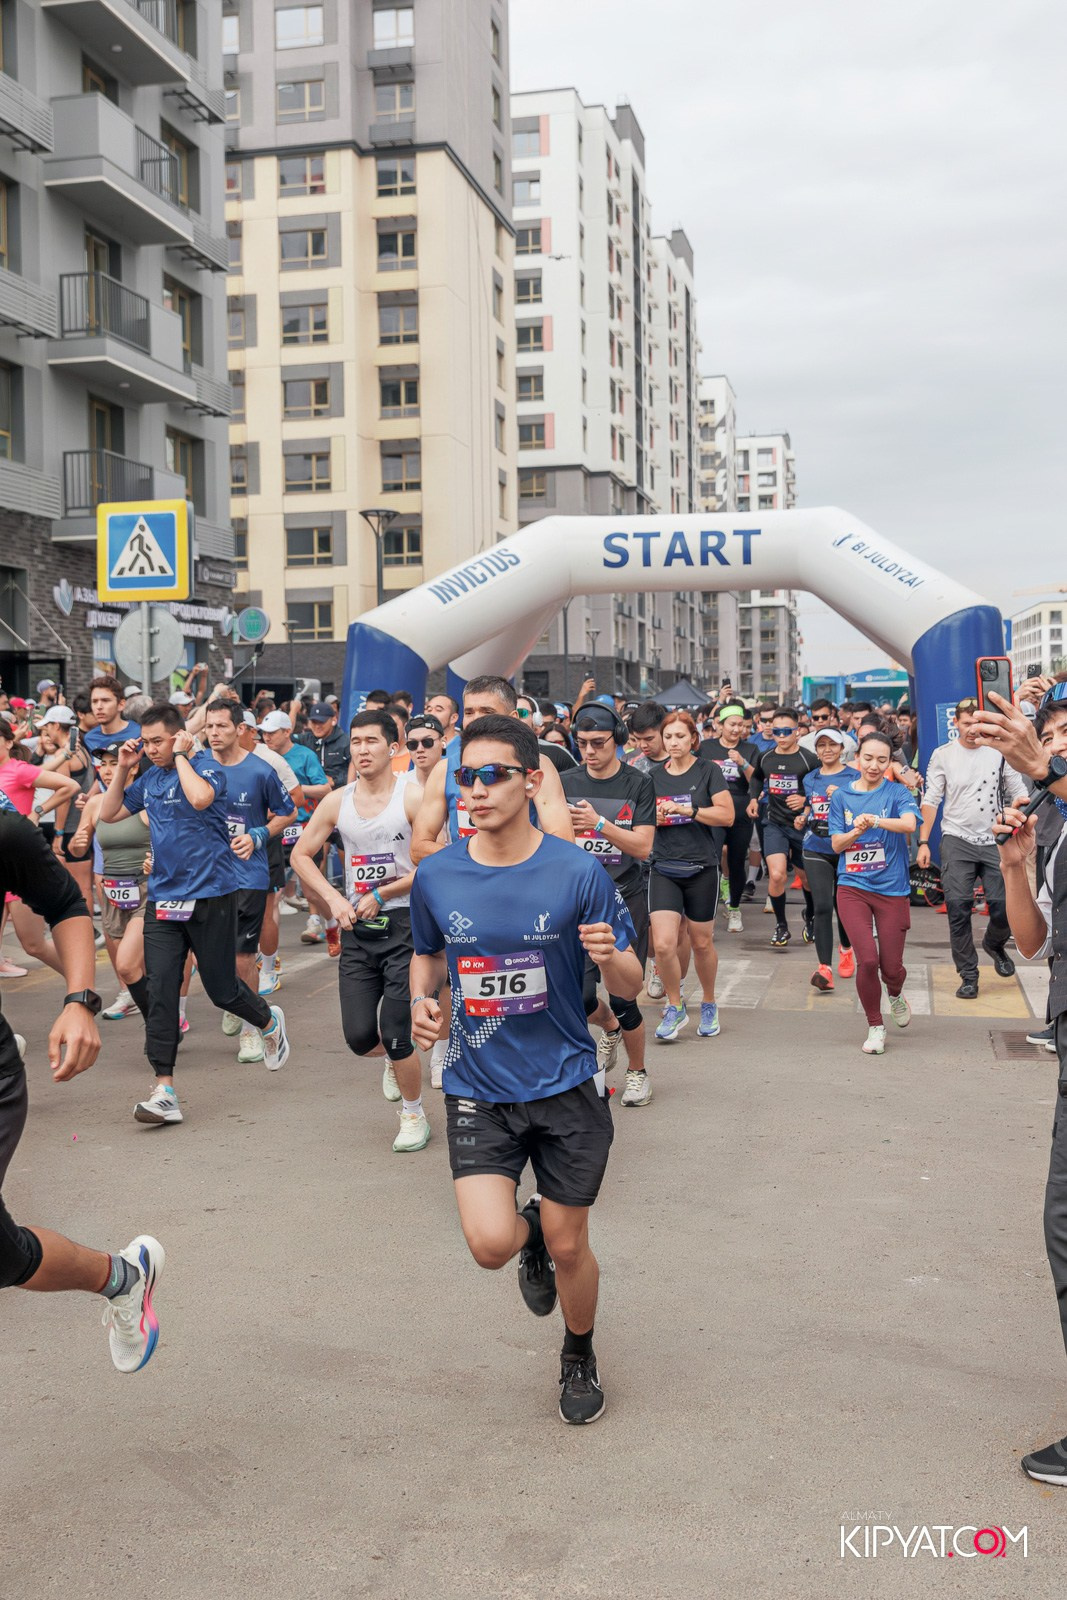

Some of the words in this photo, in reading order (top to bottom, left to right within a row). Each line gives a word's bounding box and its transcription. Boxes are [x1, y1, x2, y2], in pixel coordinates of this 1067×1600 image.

[603, 529, 762, 568] START
[851, 541, 870, 555] BI
[864, 551, 924, 588] JULDYZAI
[427, 548, 521, 605] INVICTUS
[775, 780, 792, 788] 255
[583, 840, 614, 853] 052
[852, 851, 877, 862] 497
[356, 865, 387, 880] 029
[110, 889, 130, 900] 016
[531, 933, 560, 941] JULDYZAI
[461, 960, 471, 968] 10
[479, 973, 527, 997] 516
